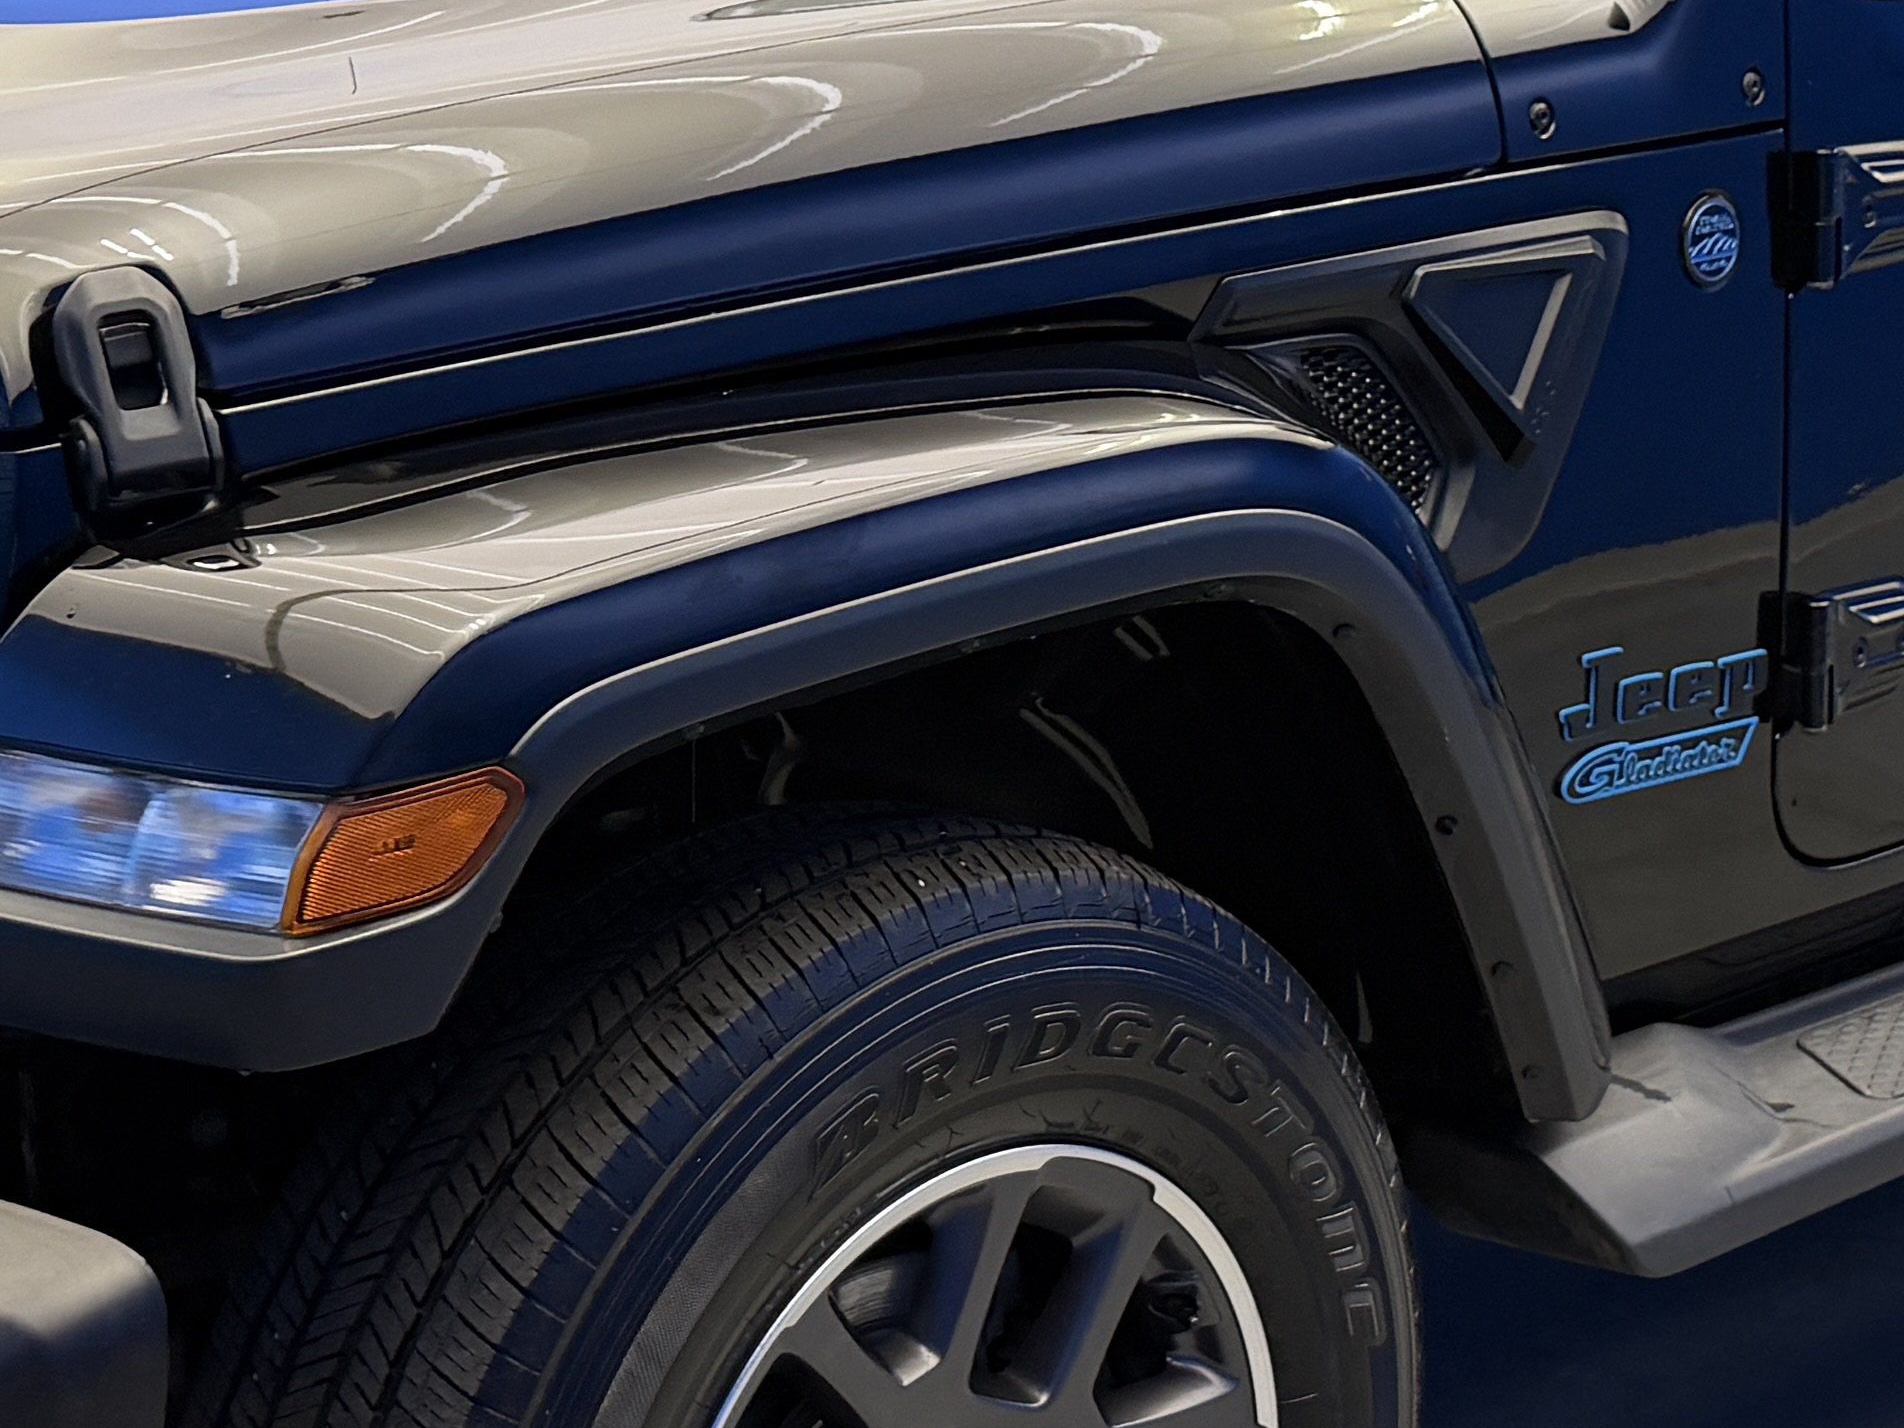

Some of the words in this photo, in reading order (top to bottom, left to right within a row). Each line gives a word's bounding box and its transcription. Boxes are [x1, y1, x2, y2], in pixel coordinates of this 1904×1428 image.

[1557, 645, 1769, 743] Jeep
[1573, 736, 1740, 794] Gladiator
[808, 998, 1390, 1348] BRIDGESTONE
